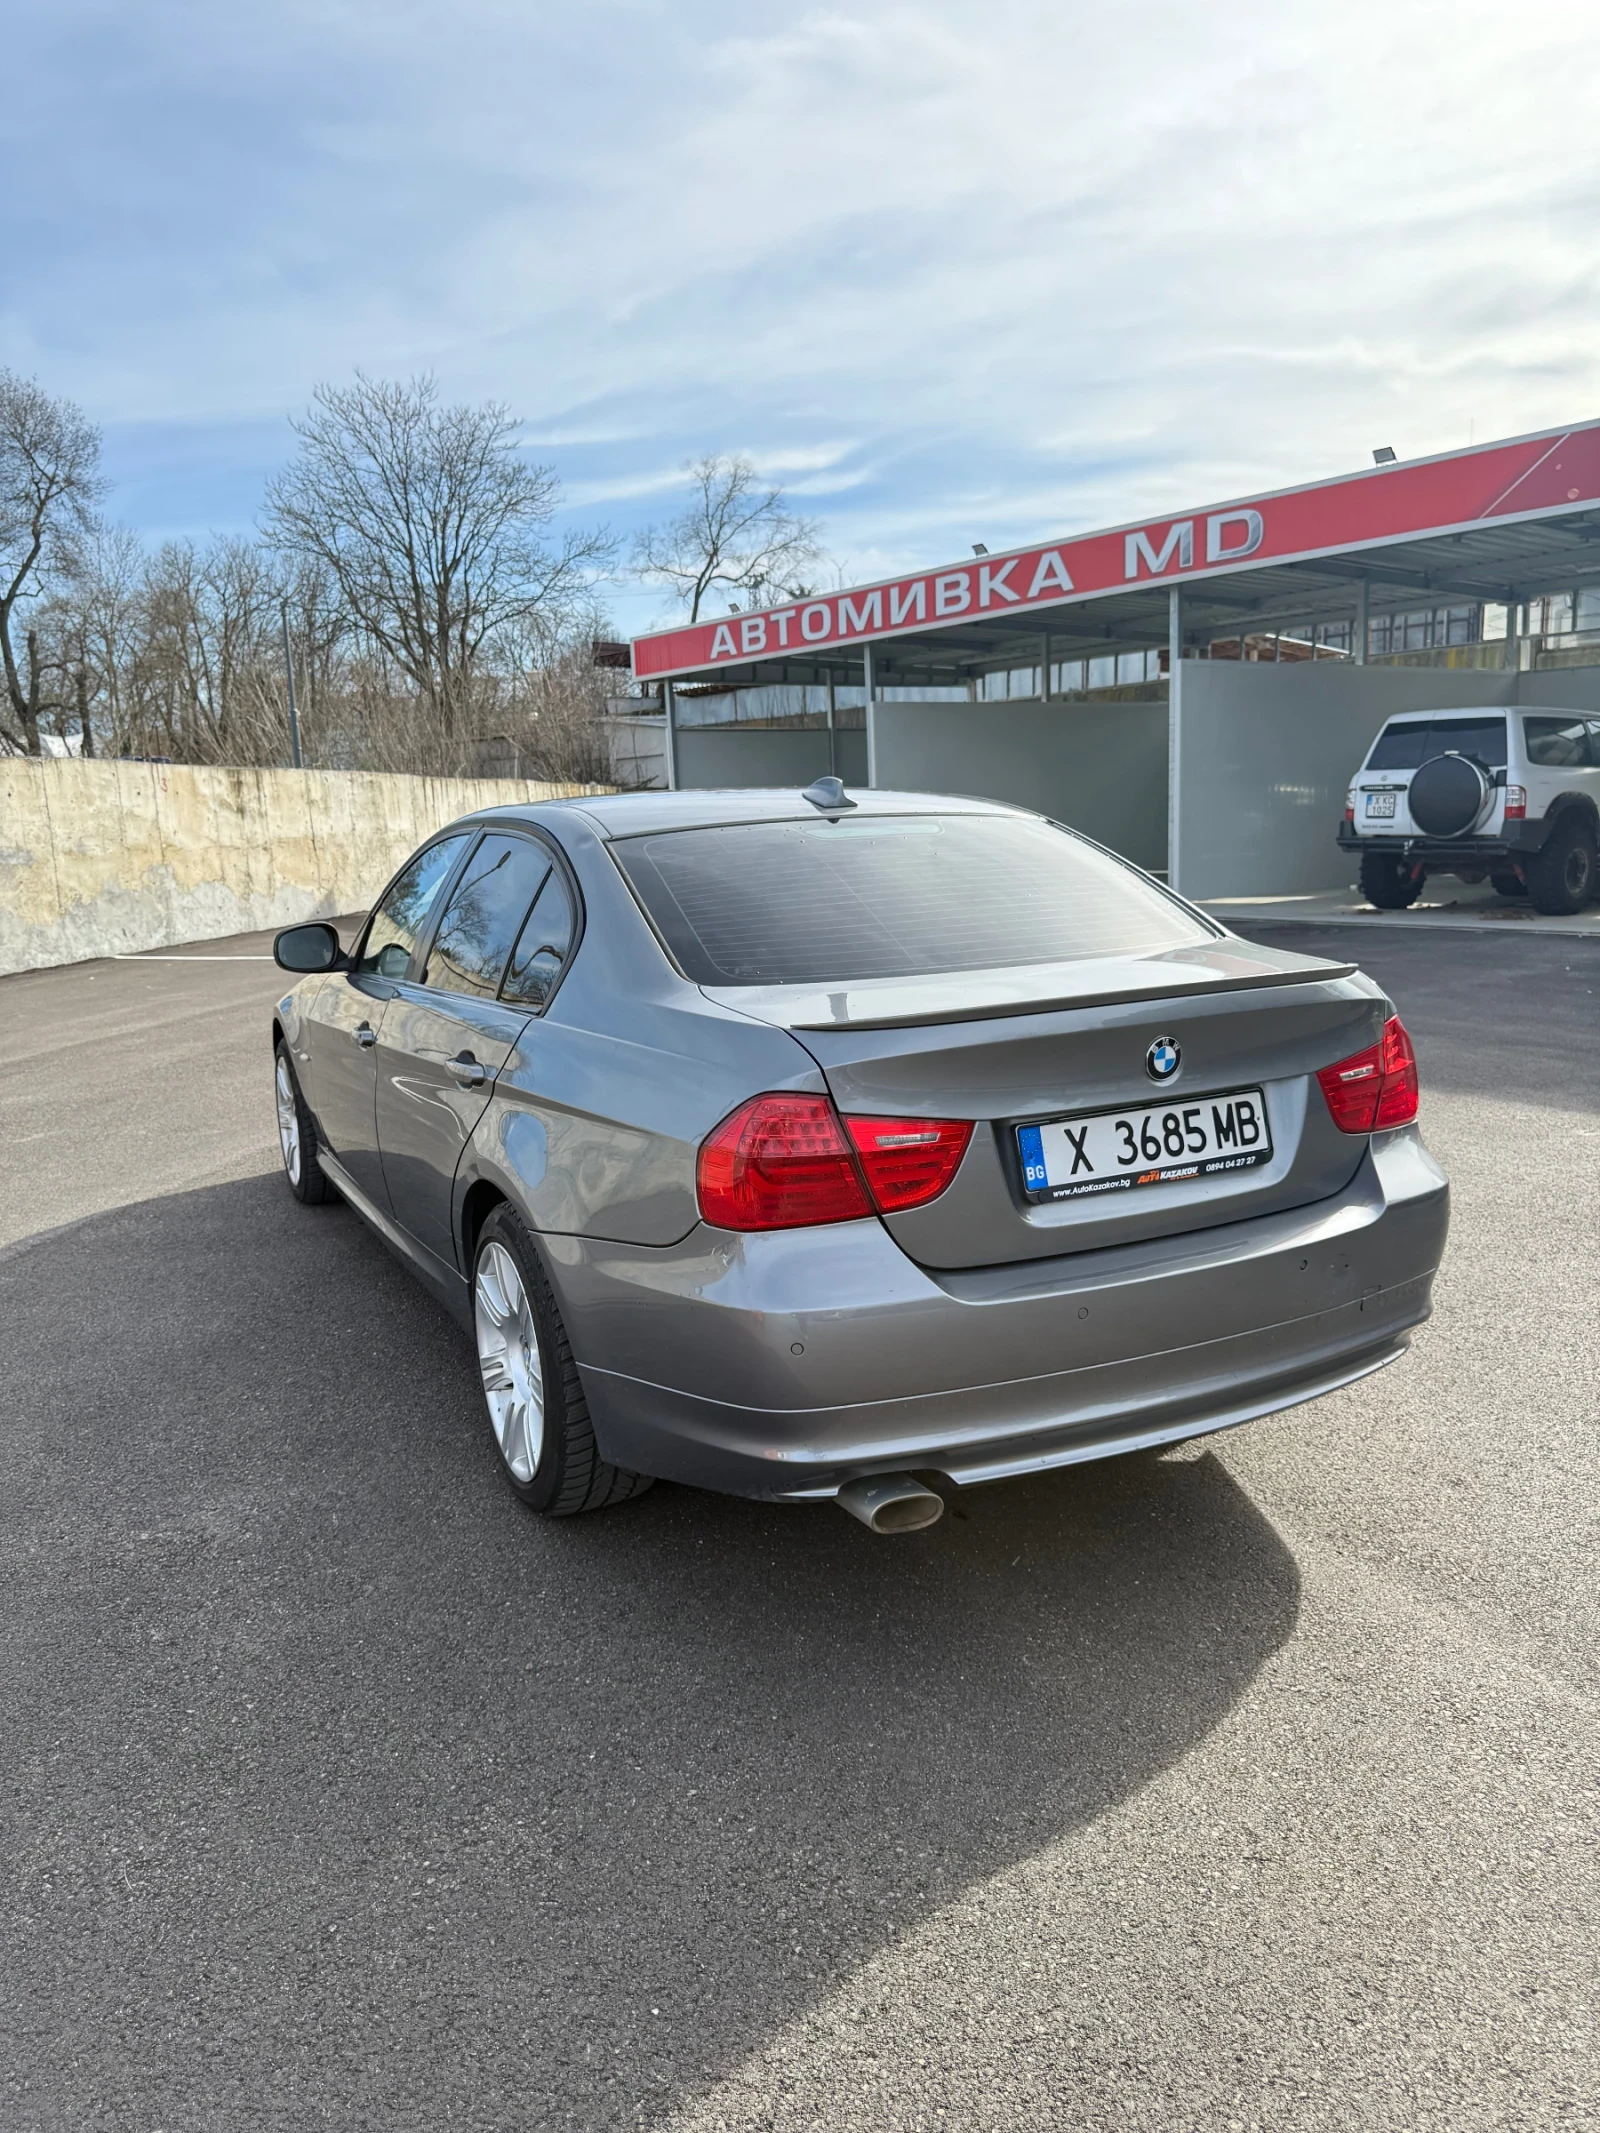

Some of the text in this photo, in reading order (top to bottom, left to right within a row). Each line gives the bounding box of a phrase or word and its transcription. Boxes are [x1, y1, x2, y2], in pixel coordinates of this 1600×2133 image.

[708, 508, 1264, 661] АВТОМИВКА MD
[1151, 1038, 1181, 1054] BMW
[1063, 1100, 1260, 1175] X 3685 MB
[1205, 1156, 1256, 1172] 0894 04 27 27
[1026, 1166, 1045, 1181] BG
[1160, 1166, 1199, 1180] KAZAKOV
[1052, 1178, 1131, 1198] www.AutoKazakov.bg
